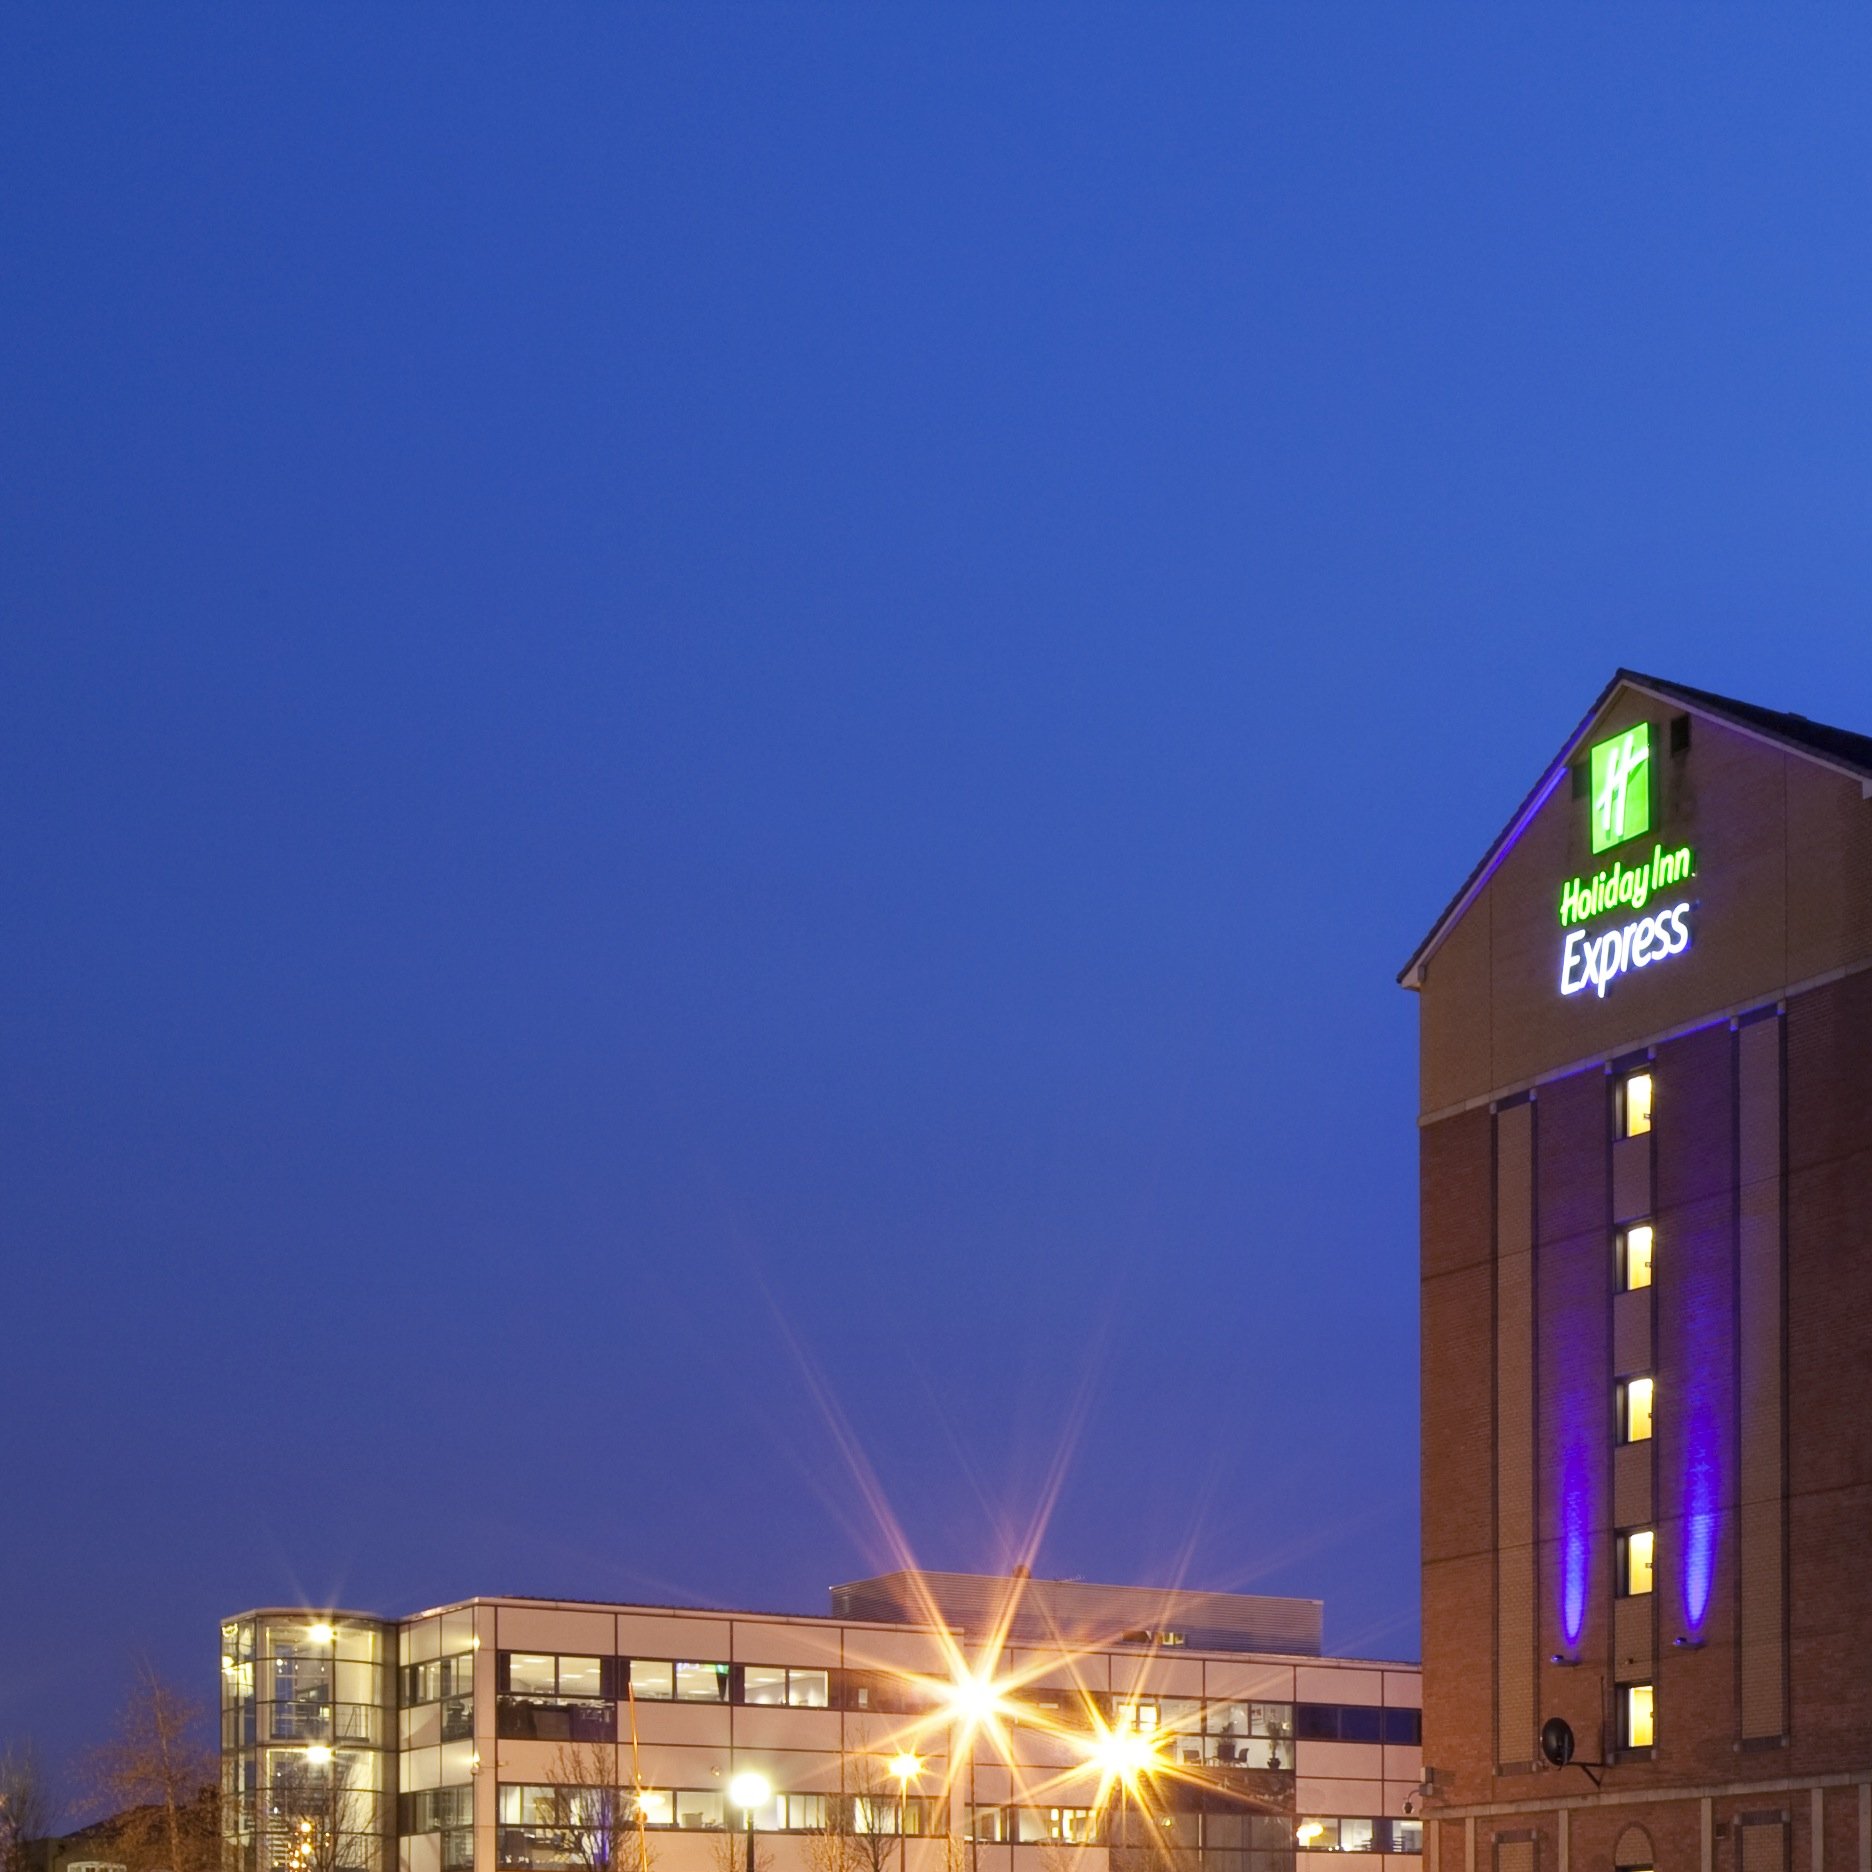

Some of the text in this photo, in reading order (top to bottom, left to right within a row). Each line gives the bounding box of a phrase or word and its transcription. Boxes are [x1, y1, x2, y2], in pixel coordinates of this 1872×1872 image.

[1560, 844, 1691, 926] Holiday Inn
[1560, 902, 1691, 999] Express
